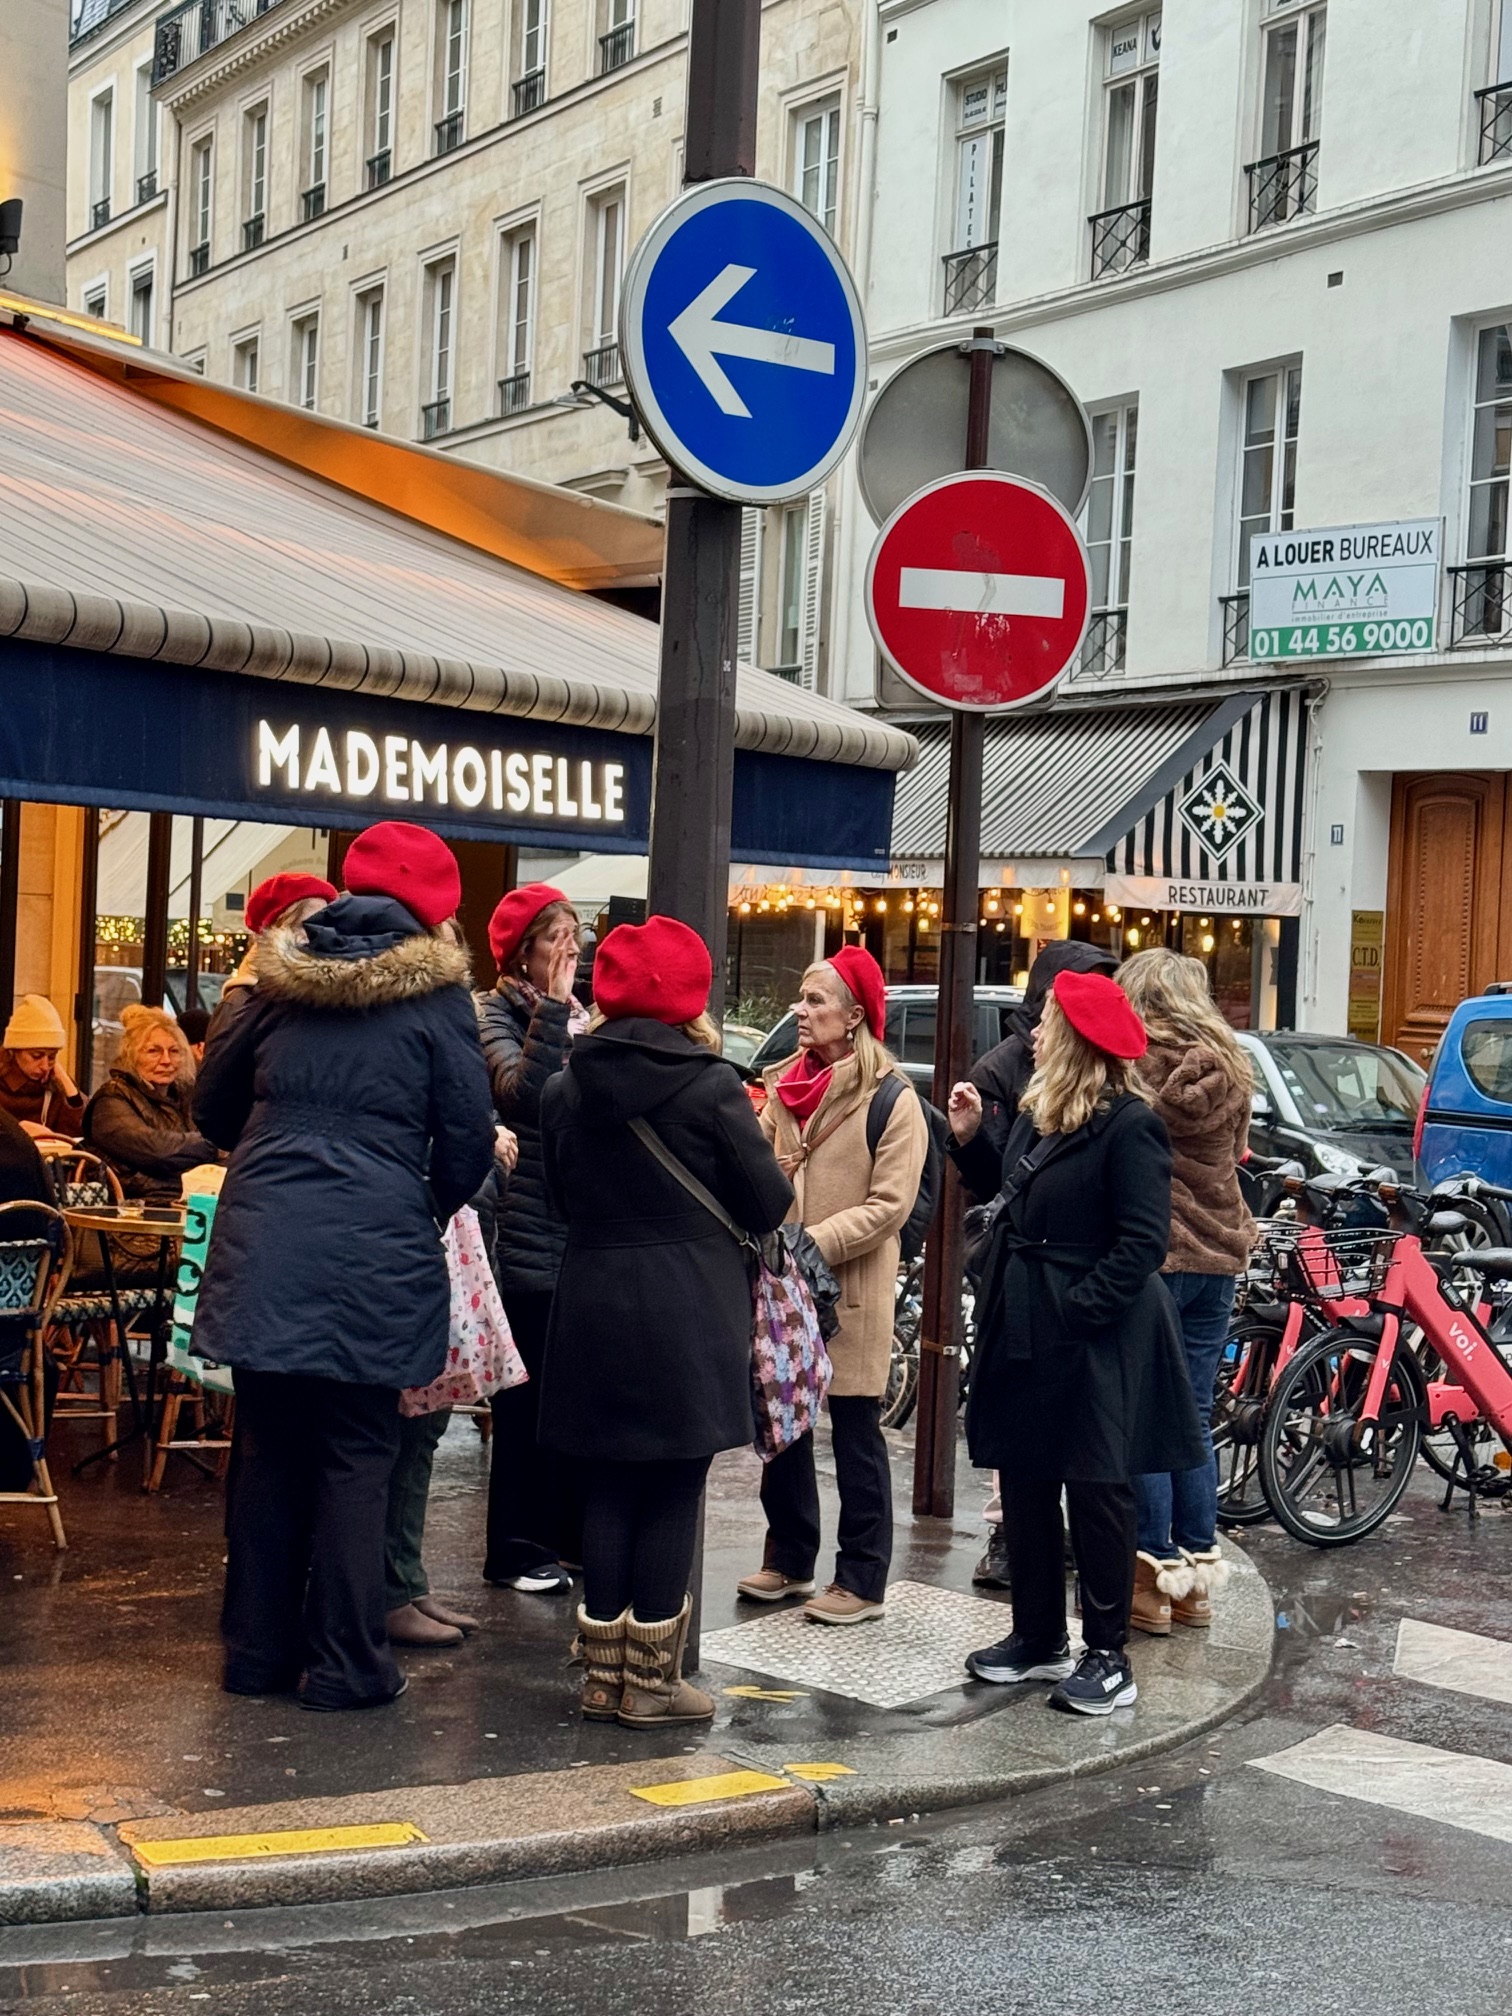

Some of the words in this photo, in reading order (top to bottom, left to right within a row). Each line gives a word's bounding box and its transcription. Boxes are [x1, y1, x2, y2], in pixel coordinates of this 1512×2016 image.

[1256, 546, 1269, 568] A
[1274, 540, 1335, 566] LOUER
[1340, 530, 1433, 561] BUREAUX
[1292, 572, 1388, 602] MAYA
[1291, 595, 1389, 611] FINANCE
[1291, 613, 1335, 623] immobilier
[1337, 610, 1389, 622] d'entreprise
[1254, 630, 1280, 657] 01
[1288, 628, 1320, 653] 44
[1326, 625, 1357, 652] 56
[1362, 620, 1429, 649] 9000
[1472, 715, 1484, 731] 11
[258, 718, 625, 821] MADEMOISELLE
[1168, 885, 1270, 907] RESTAURANT
